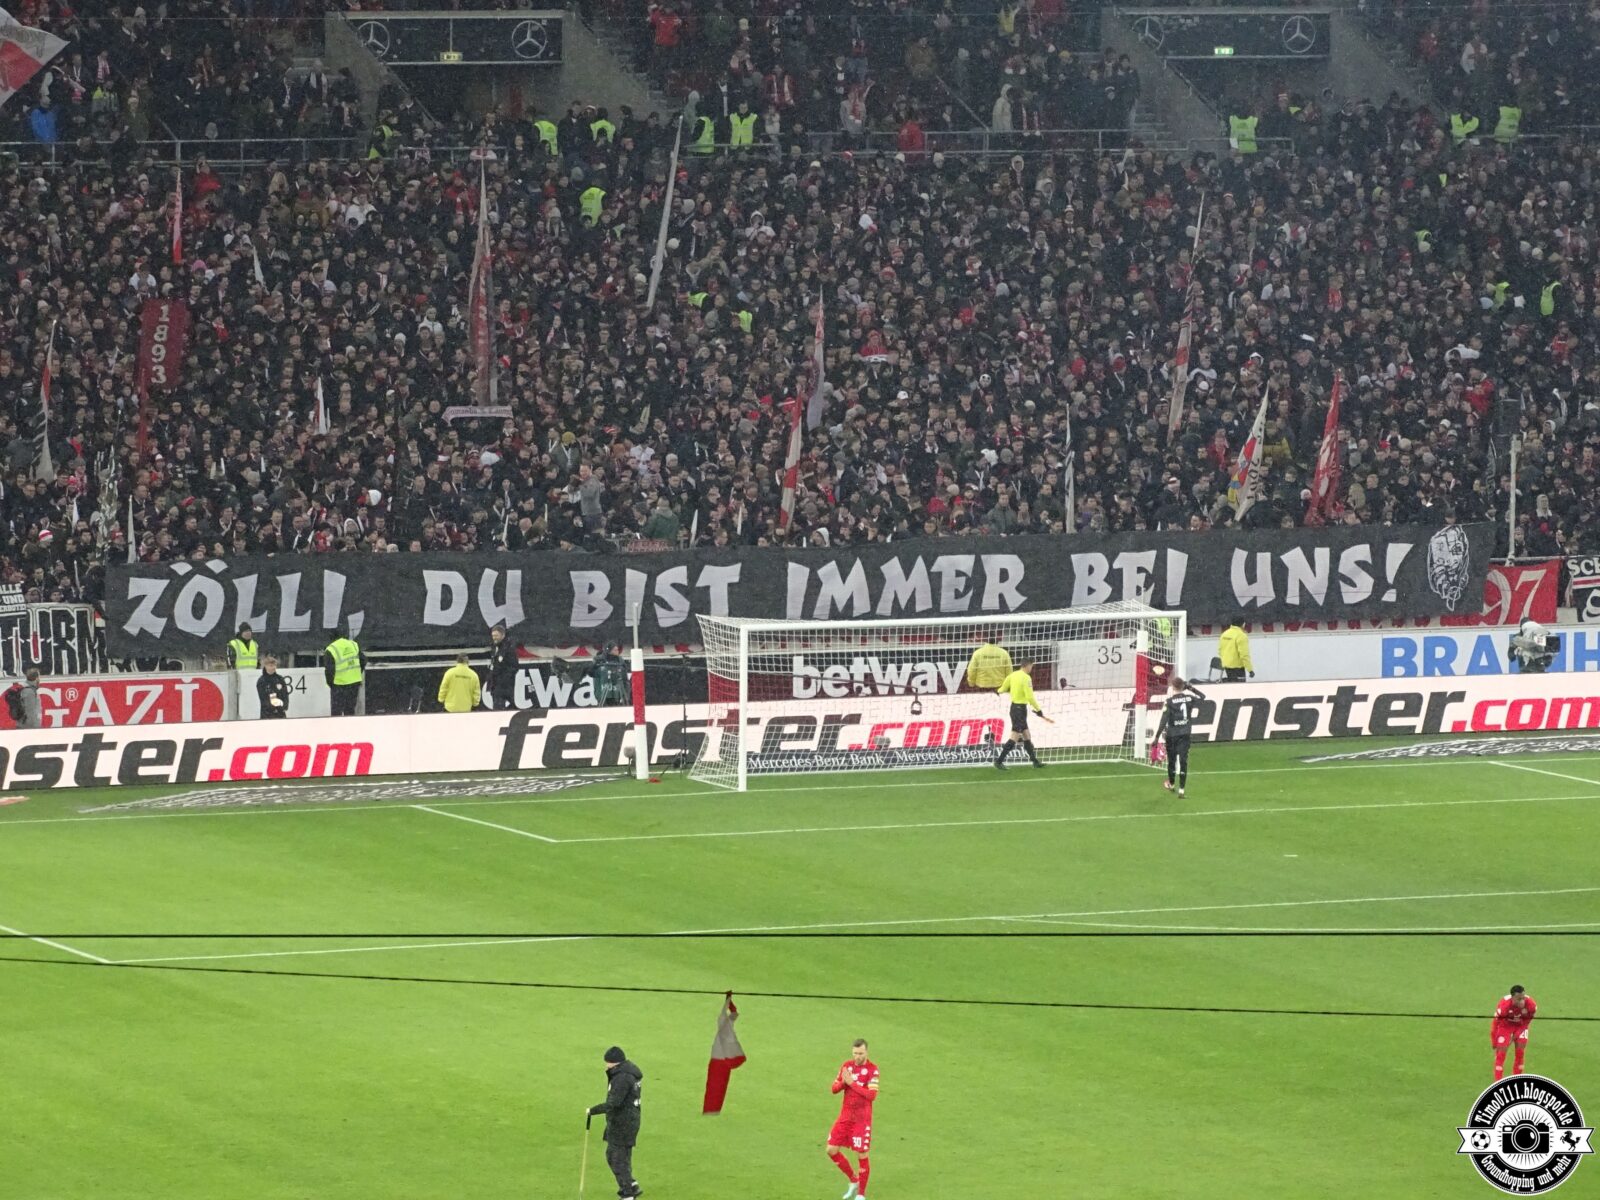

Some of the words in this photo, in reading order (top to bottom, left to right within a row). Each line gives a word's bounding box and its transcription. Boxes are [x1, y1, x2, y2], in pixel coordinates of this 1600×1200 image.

[151, 304, 170, 384] 1893
[2, 594, 25, 605] UND
[422, 567, 526, 629] DU
[569, 562, 742, 628] BIST
[786, 554, 1028, 621] IMMER
[1070, 548, 1189, 606] BEI
[1230, 542, 1414, 608] UNS!
[1098, 645, 1122, 665] 35
[284, 674, 307, 695] 34
[792, 655, 969, 700] betway
[0, 732, 374, 791] ster.com
[749, 753, 846, 769] Mercedes-Benz
[849, 752, 885, 766] Bank
